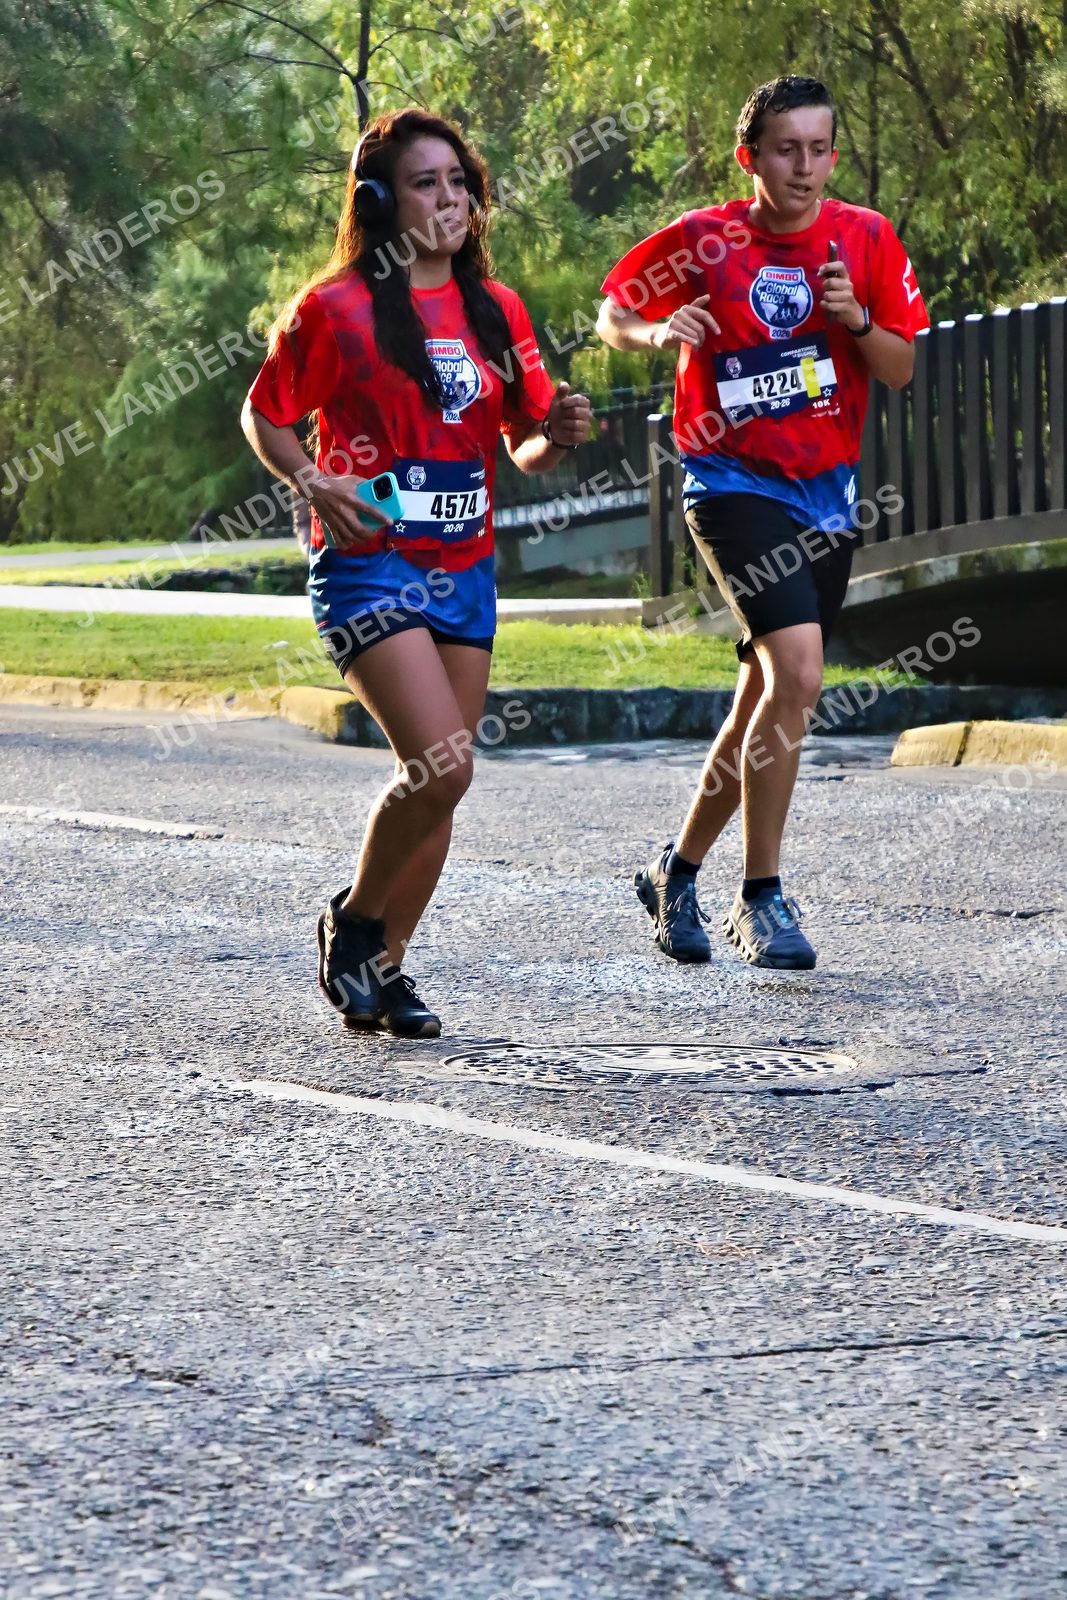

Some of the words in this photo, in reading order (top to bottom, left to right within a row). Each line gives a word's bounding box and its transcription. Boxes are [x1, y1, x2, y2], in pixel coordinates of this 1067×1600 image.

[766, 272, 798, 280] BIMBO
[766, 283, 797, 296] Global
[760, 292, 785, 304] Race
[440, 373, 452, 383] ce
[752, 368, 803, 400] 4224
[812, 399, 831, 409] 10K
[430, 492, 478, 520] 4574
